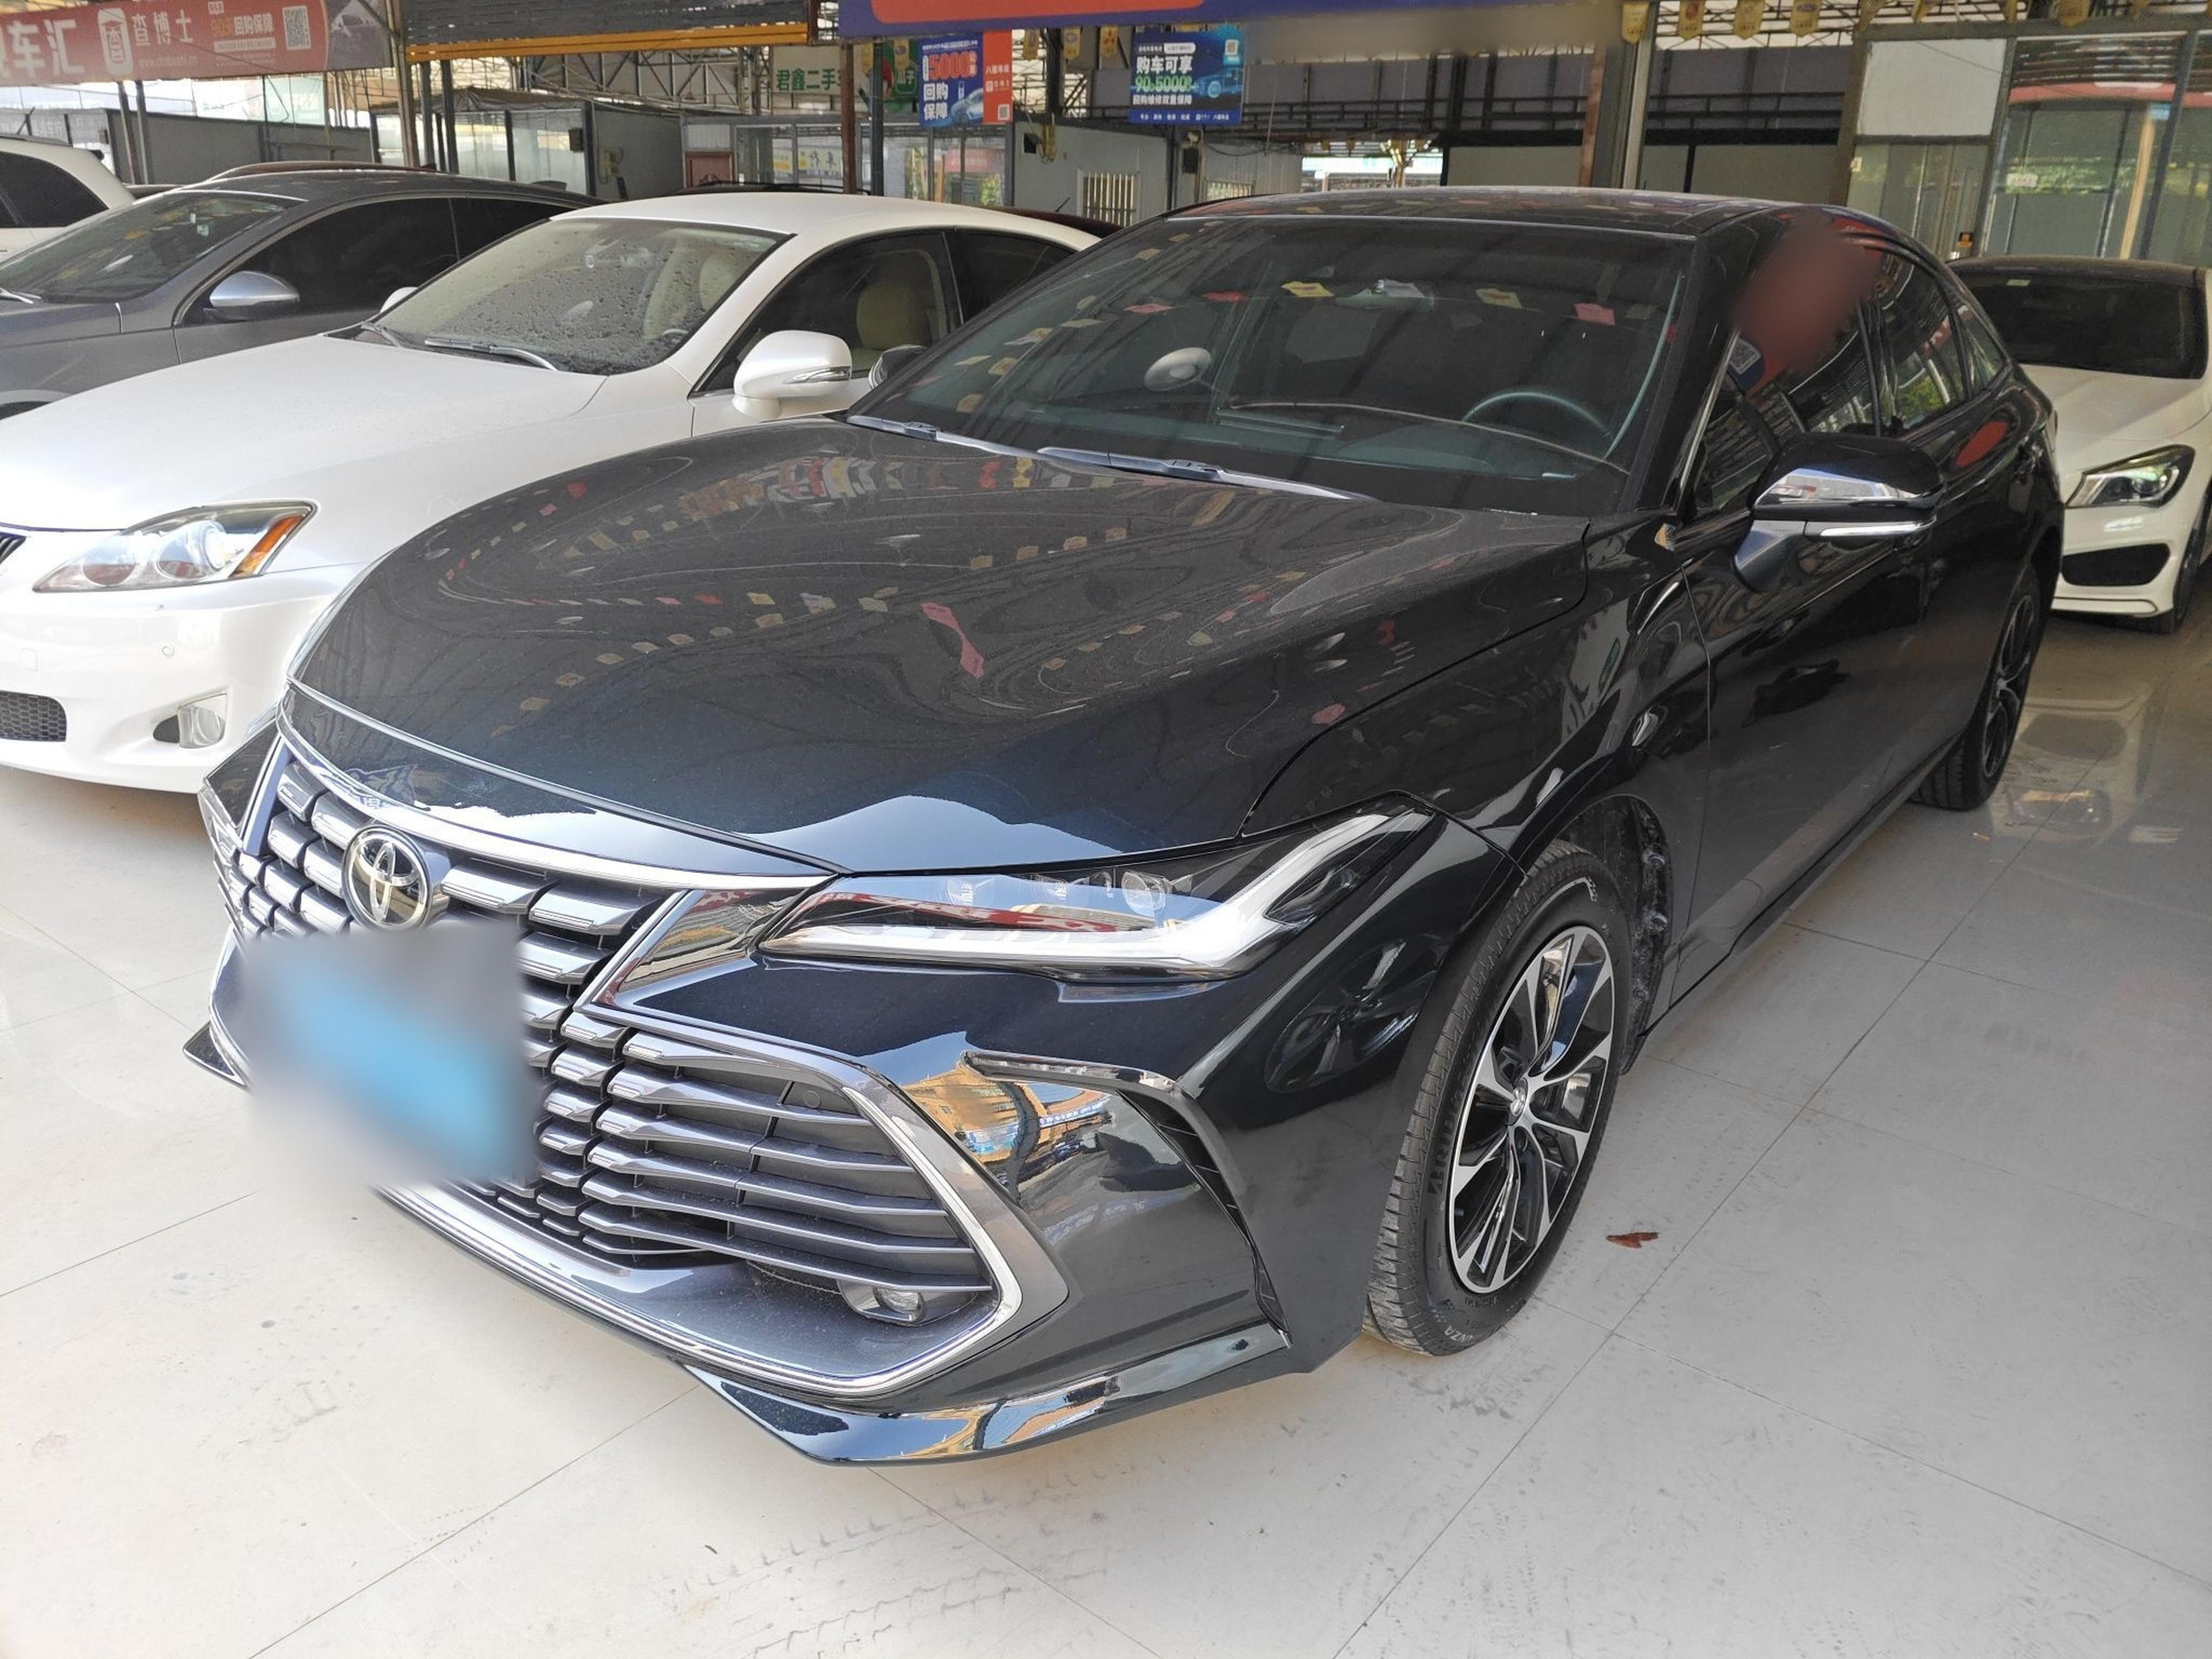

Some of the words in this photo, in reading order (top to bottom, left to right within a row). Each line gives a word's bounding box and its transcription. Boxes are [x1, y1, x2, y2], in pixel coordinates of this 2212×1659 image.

[131, 9, 194, 46] 查博士
[0, 19, 86, 78] 车汇
[1137, 55, 1192, 74] 购车可享
[923, 82, 949, 102] 回购
[923, 103, 948, 121] 保障
